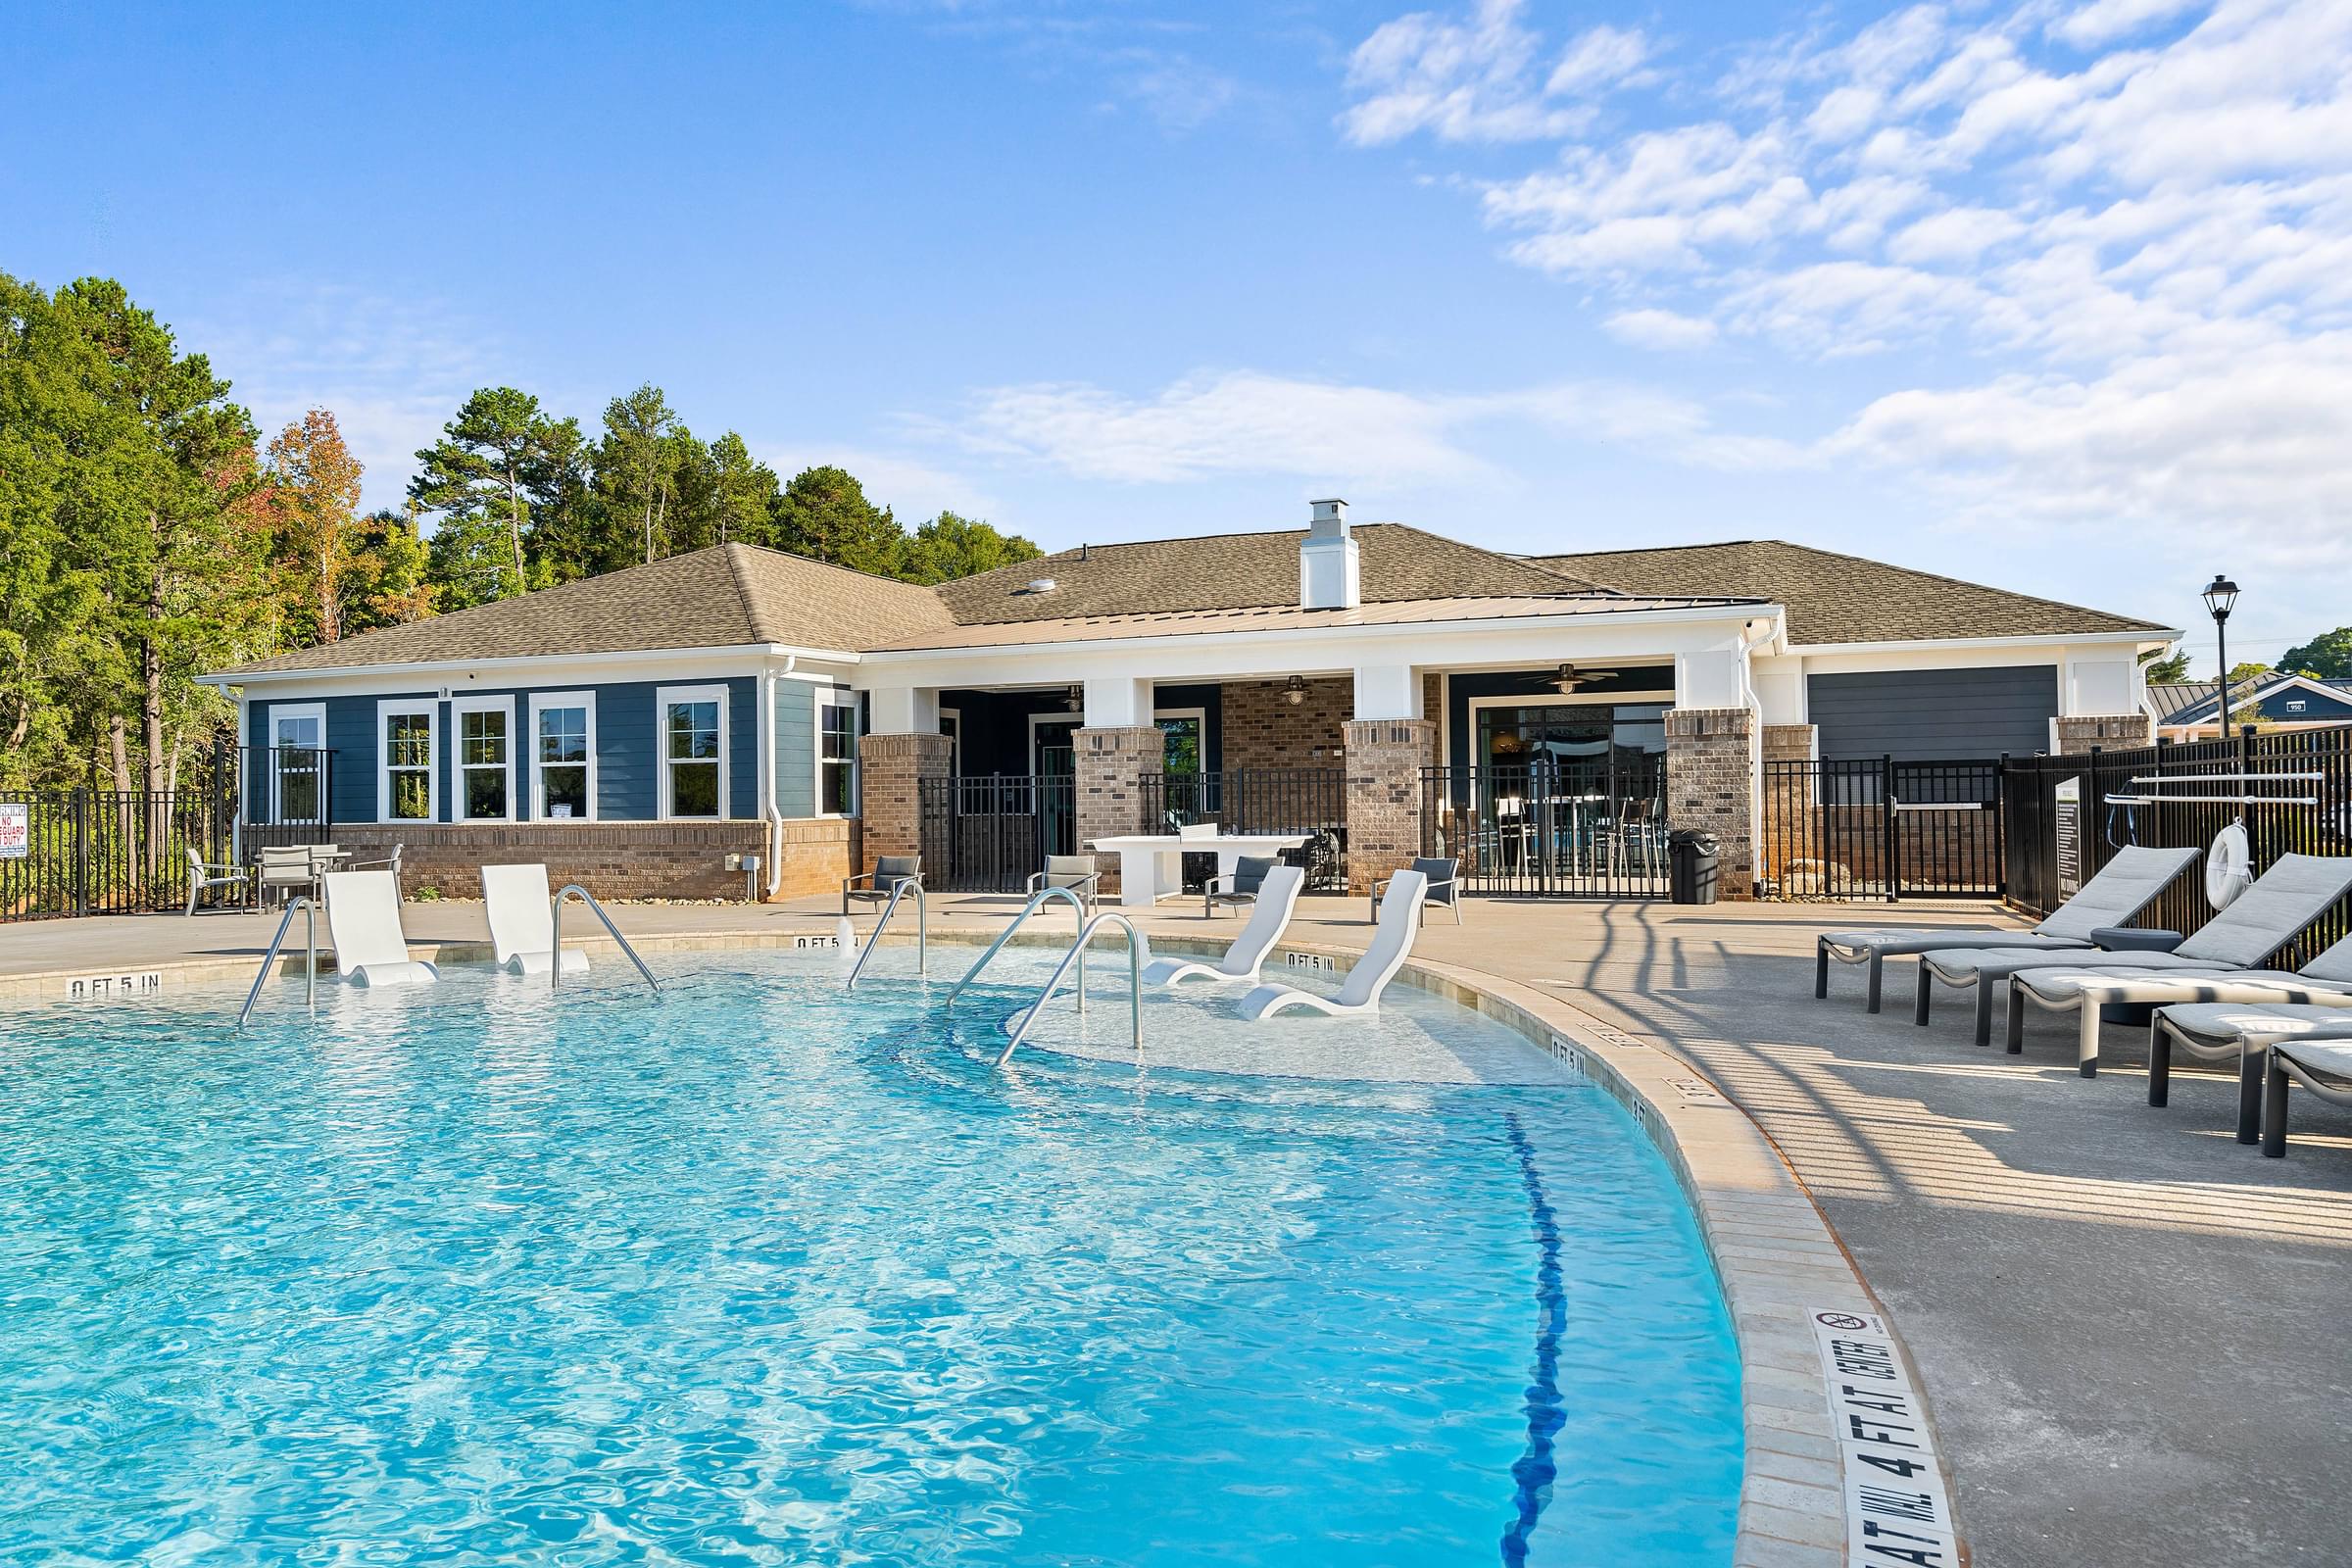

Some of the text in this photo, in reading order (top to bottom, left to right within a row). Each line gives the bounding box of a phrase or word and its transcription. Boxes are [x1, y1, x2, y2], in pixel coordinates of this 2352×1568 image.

[2, 816, 12, 825] NO
[4, 835, 21, 845] DUTY
[1298, 955, 1308, 968] FT
[1312, 956, 1319, 969] 5
[1324, 957, 1333, 971] IN
[92, 977, 113, 995] FT
[1831, 1340, 1941, 1568] AT WALL 4 FT AT CENTER
